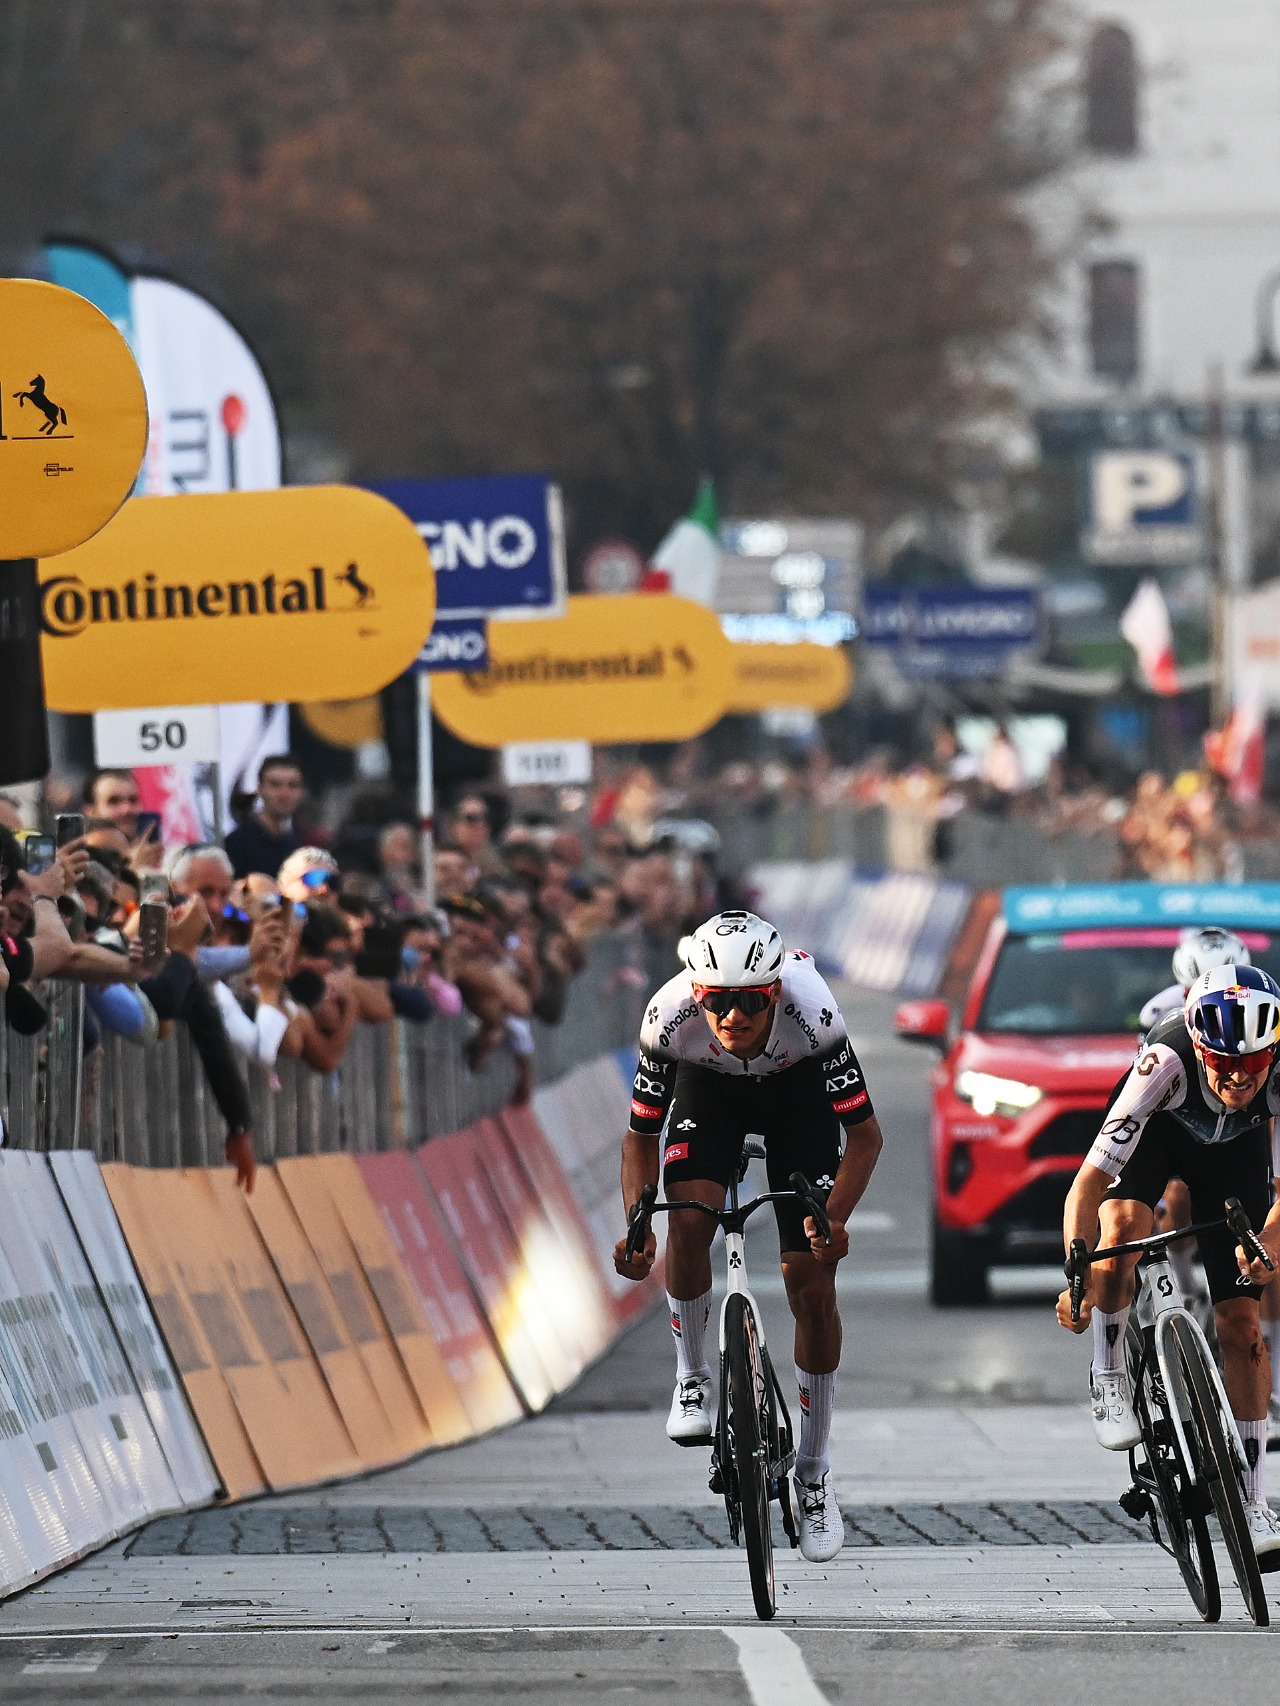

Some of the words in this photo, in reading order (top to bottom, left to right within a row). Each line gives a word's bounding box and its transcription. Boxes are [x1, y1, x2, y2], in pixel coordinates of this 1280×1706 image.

[1092, 454, 1186, 537] P
[41, 566, 326, 636] Continental
[140, 719, 187, 752] 50
[716, 924, 748, 936] G42
[664, 1003, 699, 1038] Analog
[793, 1010, 819, 1050] Analog
[1071, 1274, 1082, 1313] SRAM
